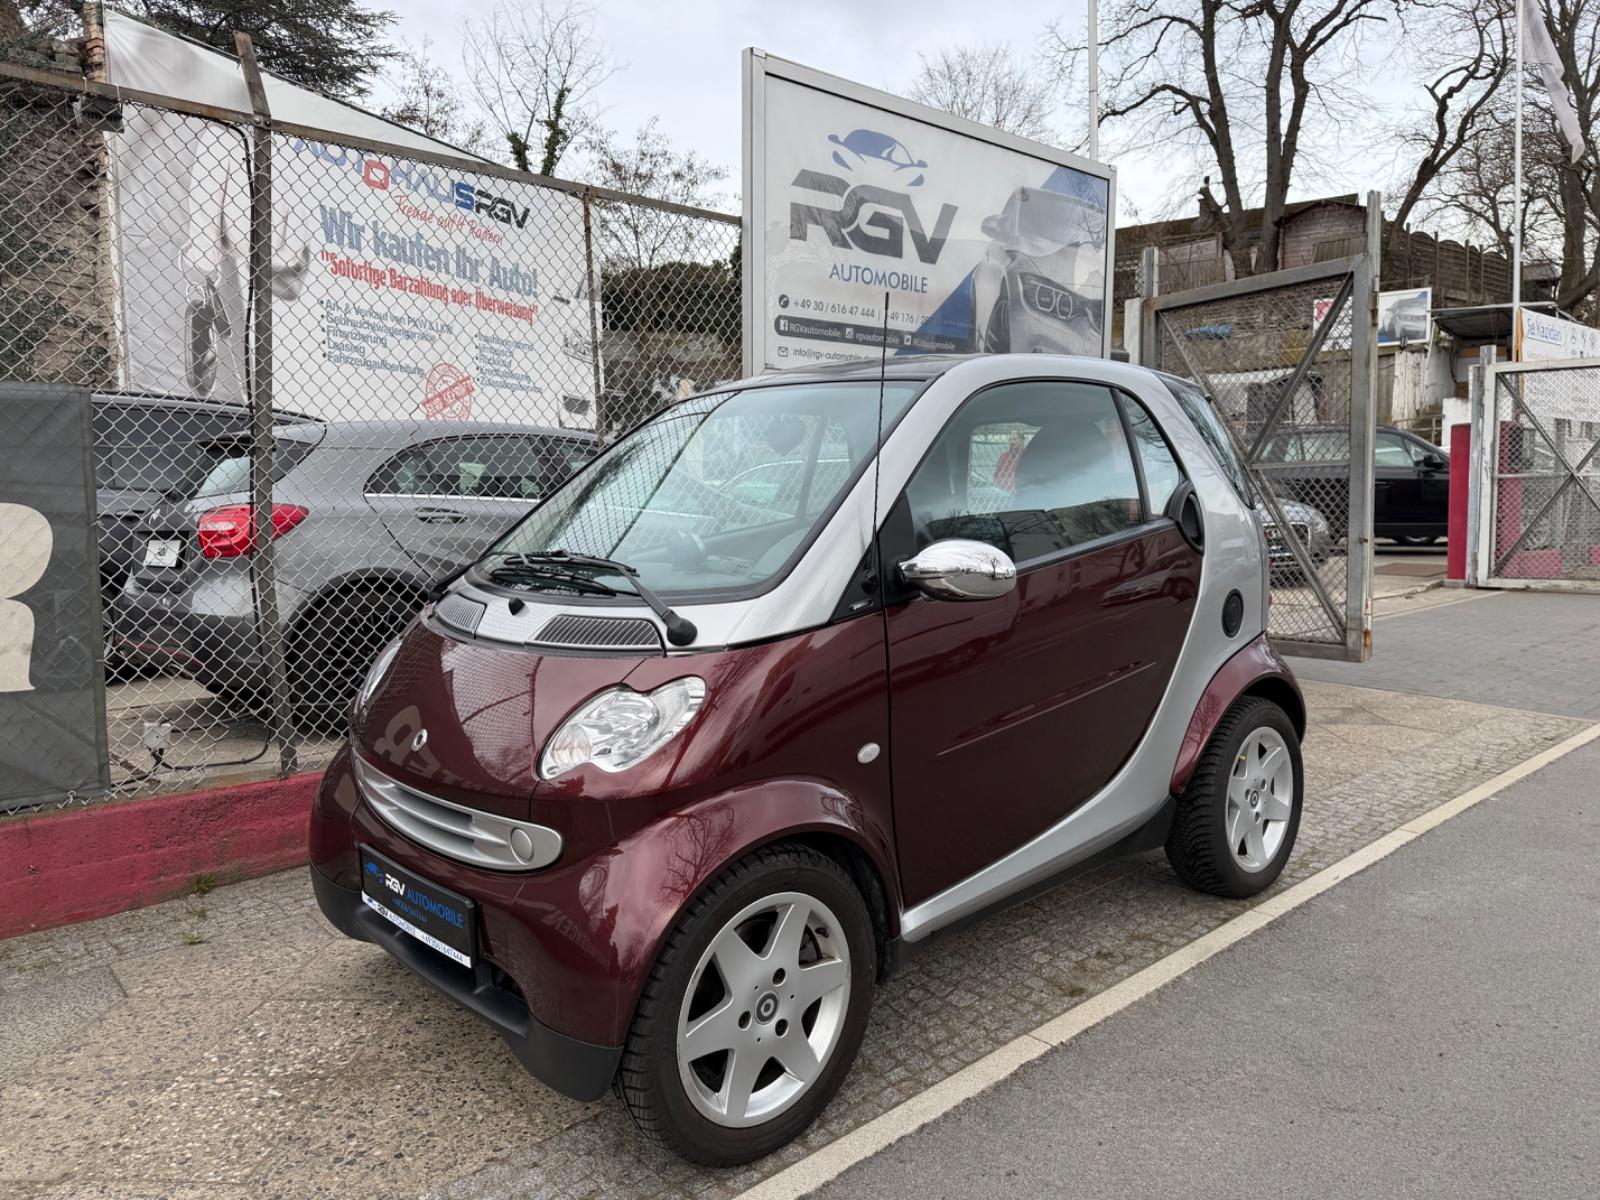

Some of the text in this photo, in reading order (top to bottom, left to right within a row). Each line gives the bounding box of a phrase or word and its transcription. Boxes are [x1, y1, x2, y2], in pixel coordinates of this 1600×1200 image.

[789, 168, 959, 265] RGV
[320, 204, 538, 298] Wir kaufen Ihr Auto!
[389, 267, 448, 304] Barzahlung
[829, 263, 928, 294] AUTOMOBILE
[793, 299, 811, 309] +49
[813, 301, 824, 312] 30
[830, 304, 847, 314] 616
[849, 306, 859, 316] 47
[860, 307, 875, 317] 444
[902, 312, 914, 324] 176
[789, 323, 841, 338] RGVautomobile
[385, 873, 406, 896] RGV
[407, 887, 463, 929] AUTOMOBILE
